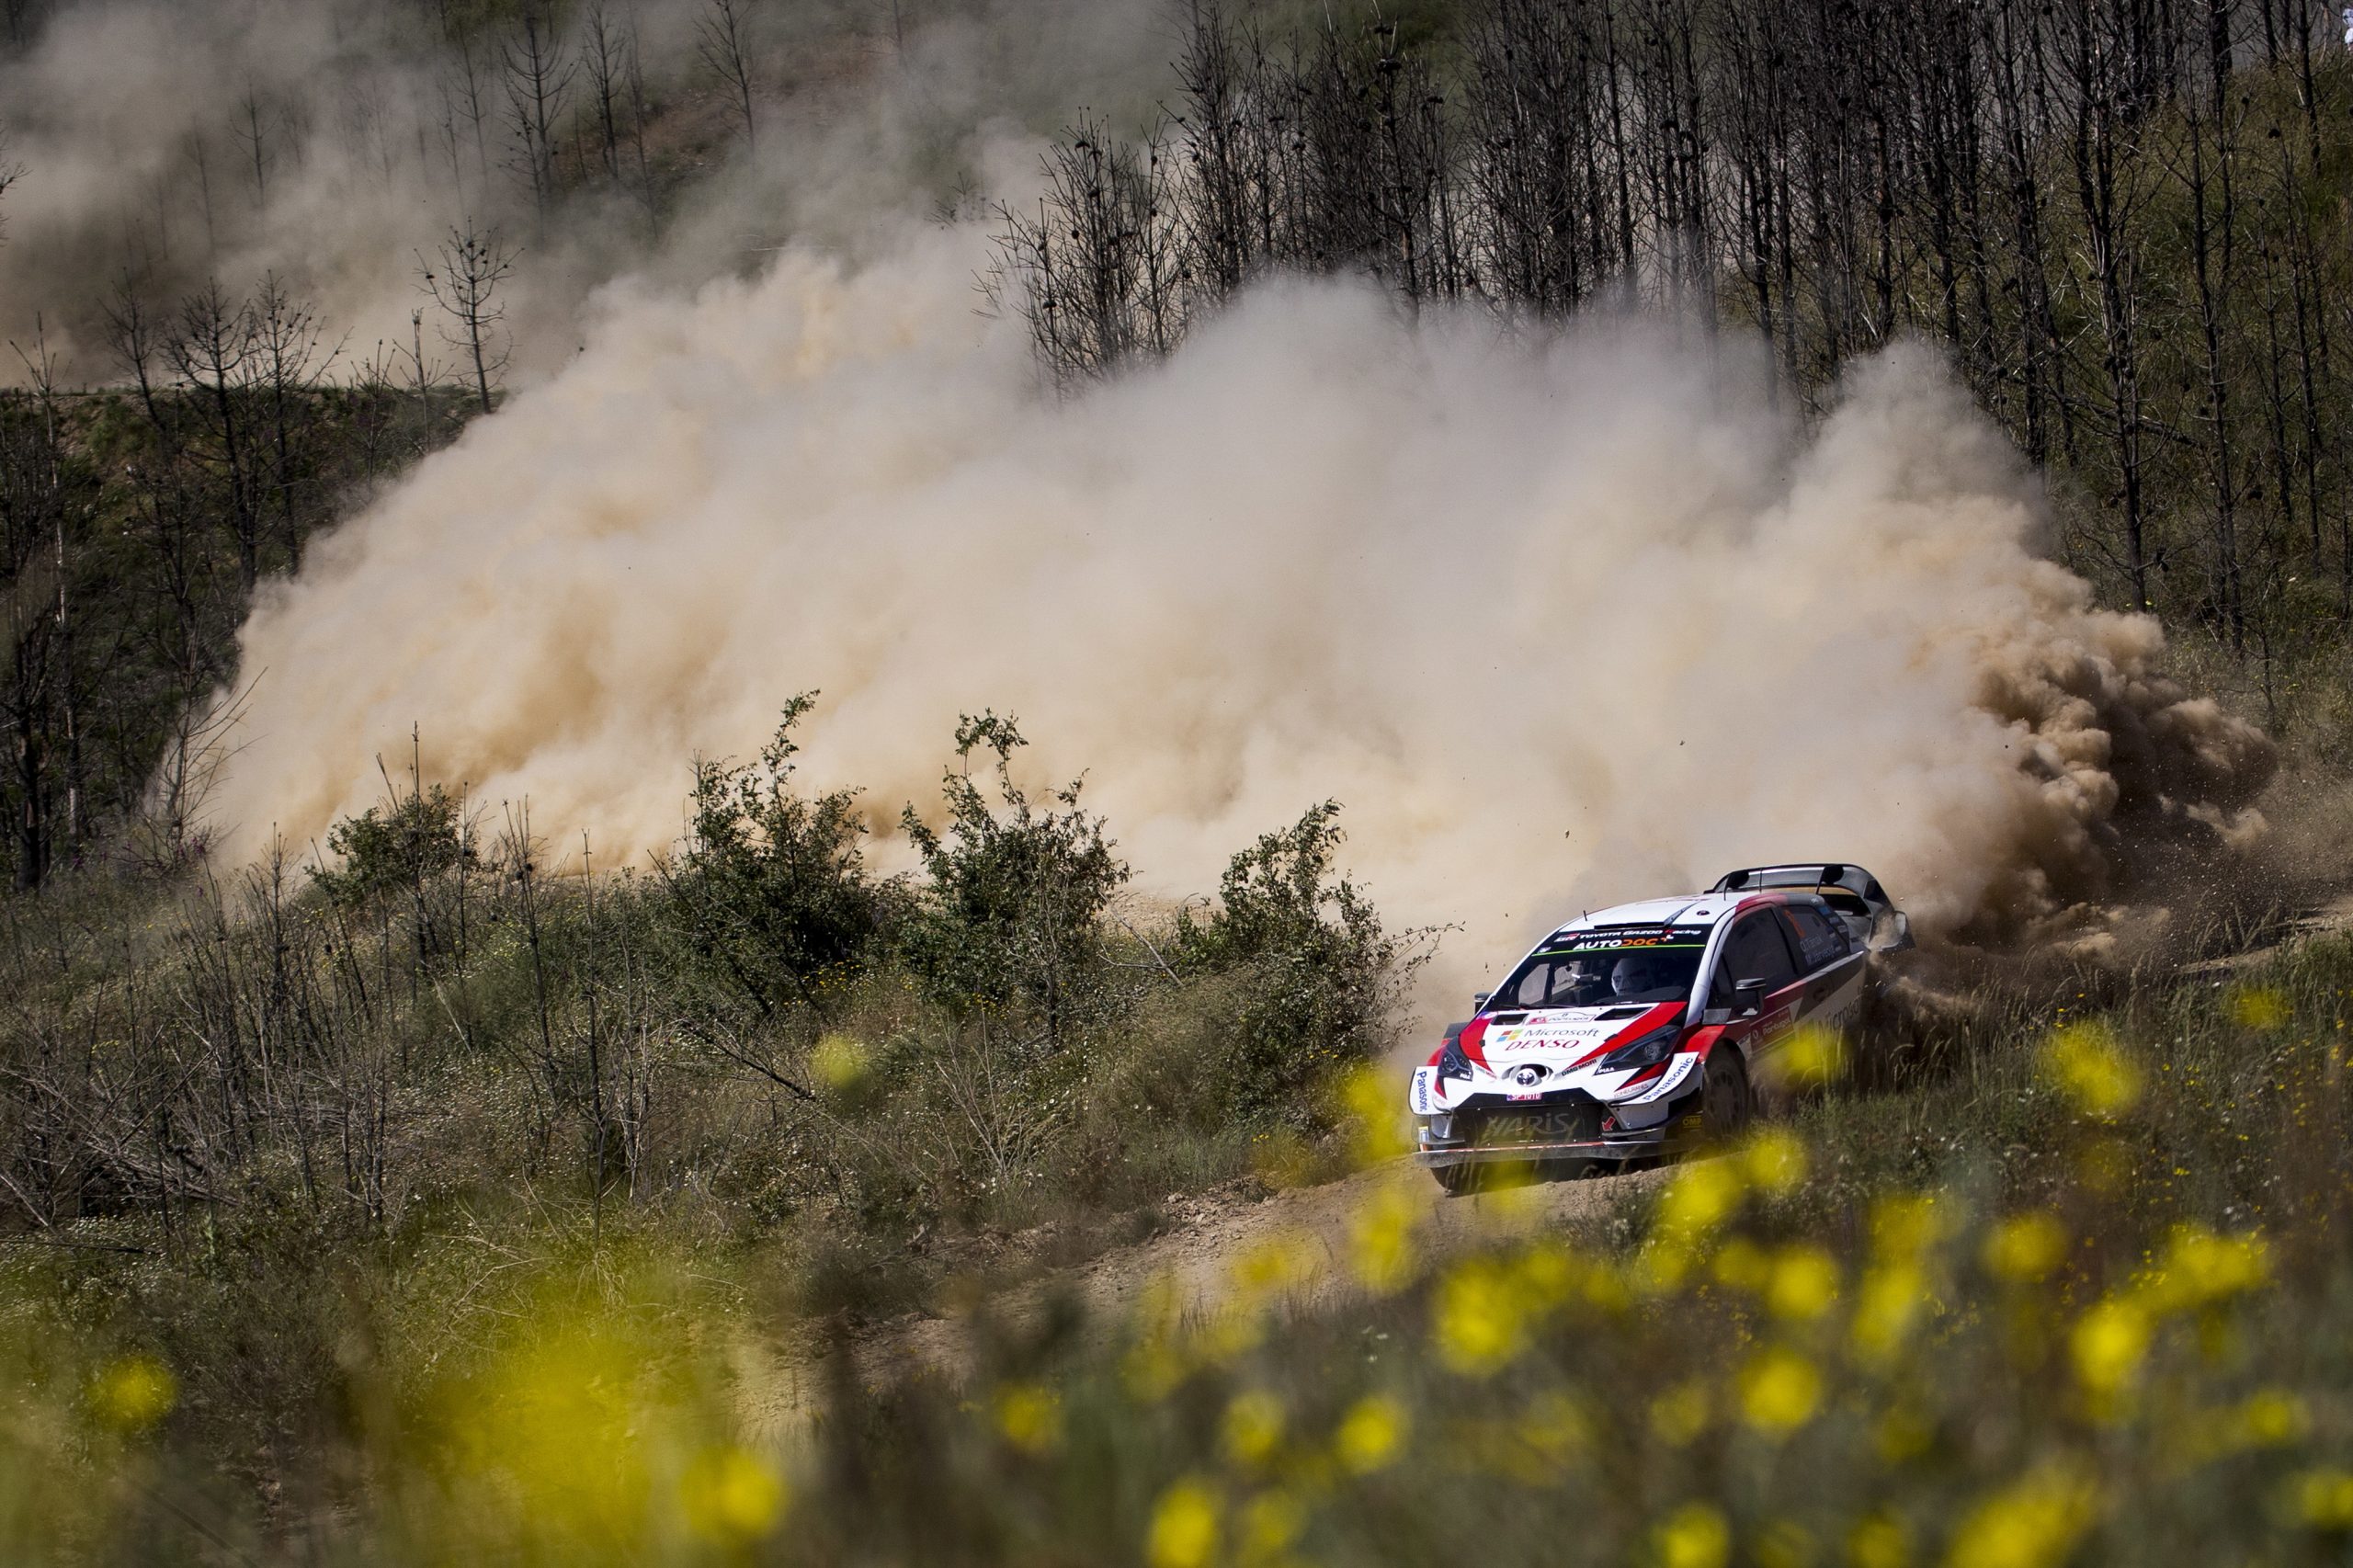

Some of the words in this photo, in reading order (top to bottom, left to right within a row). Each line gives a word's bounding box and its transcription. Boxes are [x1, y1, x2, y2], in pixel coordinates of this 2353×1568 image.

[1580, 931, 1621, 939] TOYOTA
[1573, 938, 1658, 950] AUTODOC
[1524, 1028, 1599, 1038] Microsoft
[1505, 1039, 1580, 1051] DENSO
[1562, 1067, 1578, 1076] DMG
[1578, 1059, 1597, 1070] MORI
[1643, 1056, 1694, 1101] Panasonic
